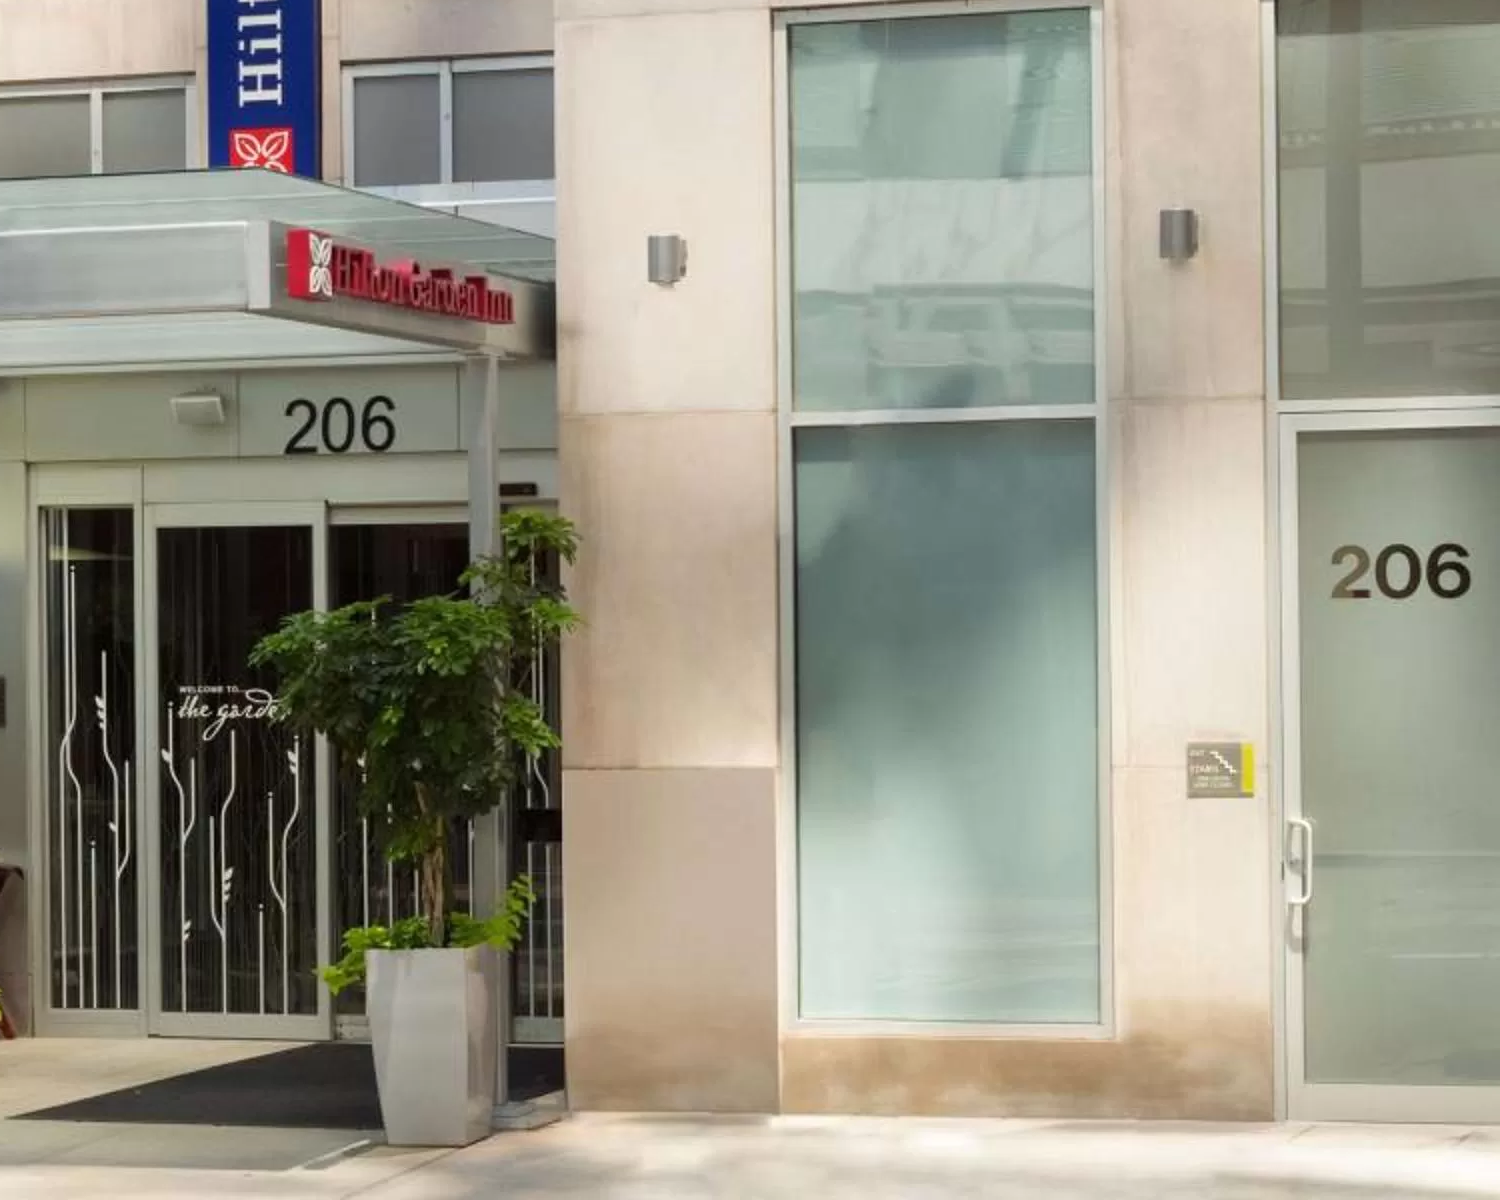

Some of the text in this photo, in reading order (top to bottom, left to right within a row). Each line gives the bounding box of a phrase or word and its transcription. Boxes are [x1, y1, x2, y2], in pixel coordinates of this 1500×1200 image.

[332, 246, 404, 304] Hilton
[410, 261, 481, 320] Garden
[284, 395, 397, 455] 206
[1331, 543, 1472, 599] 206
[177, 694, 213, 719] the
